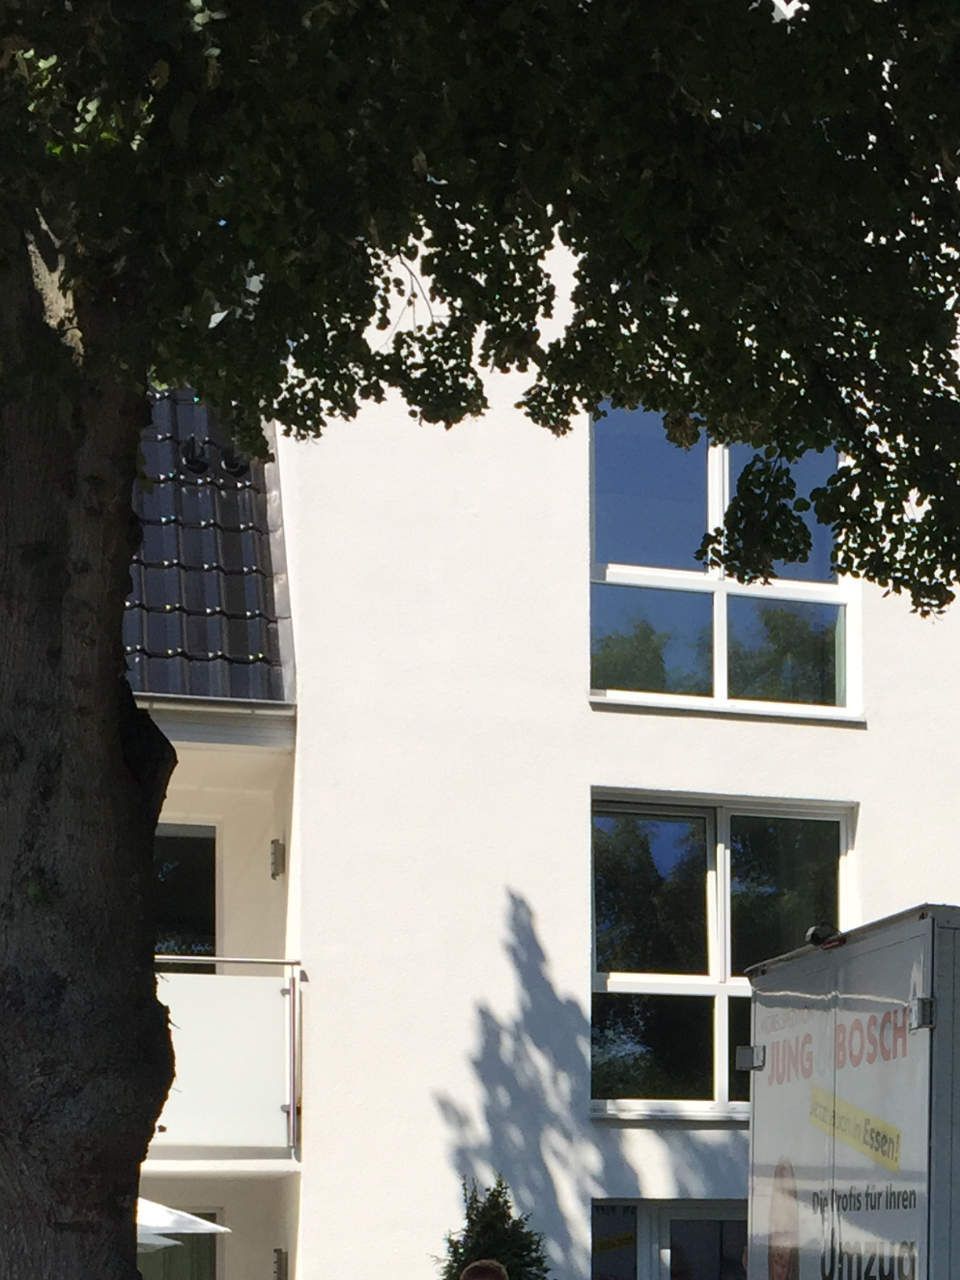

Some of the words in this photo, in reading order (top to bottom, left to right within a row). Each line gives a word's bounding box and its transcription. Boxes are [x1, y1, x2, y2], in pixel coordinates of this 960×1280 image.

[767, 1032, 813, 1087] JUNG
[835, 1007, 909, 1070] BOSCH
[862, 1118, 901, 1163] Essen!
[812, 1191, 829, 1214] Die
[865, 1185, 882, 1212] für
[885, 1184, 917, 1210] Ihren
